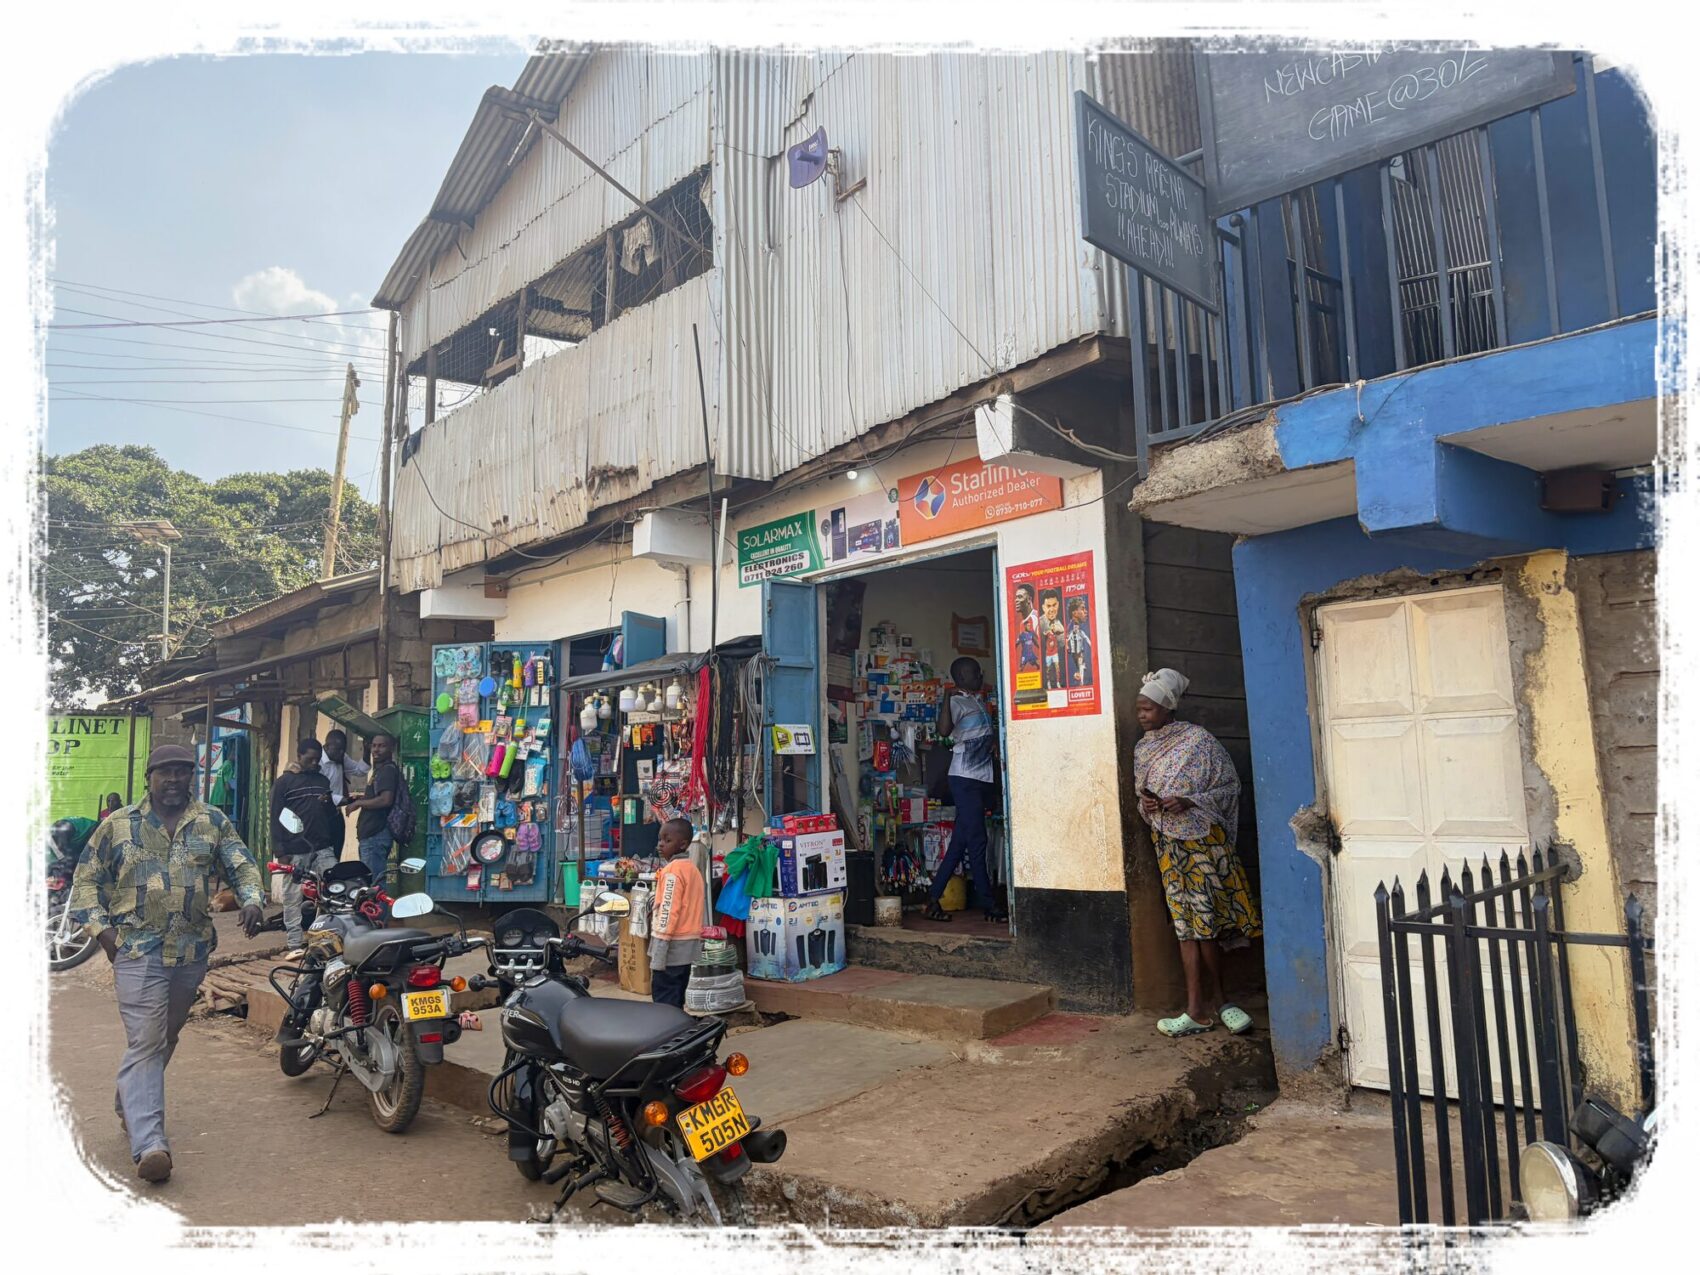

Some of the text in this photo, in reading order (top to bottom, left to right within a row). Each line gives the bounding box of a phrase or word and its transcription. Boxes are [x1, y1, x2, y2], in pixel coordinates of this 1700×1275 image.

[951, 464, 1038, 495] StarTim
[952, 486, 1004, 509] Authorized
[743, 521, 803, 551] SOLARMAX
[410, 995, 442, 1007] KMGS
[412, 1004, 442, 1016] 953A
[688, 1090, 737, 1131] KMGR
[699, 1112, 748, 1153] 505N
